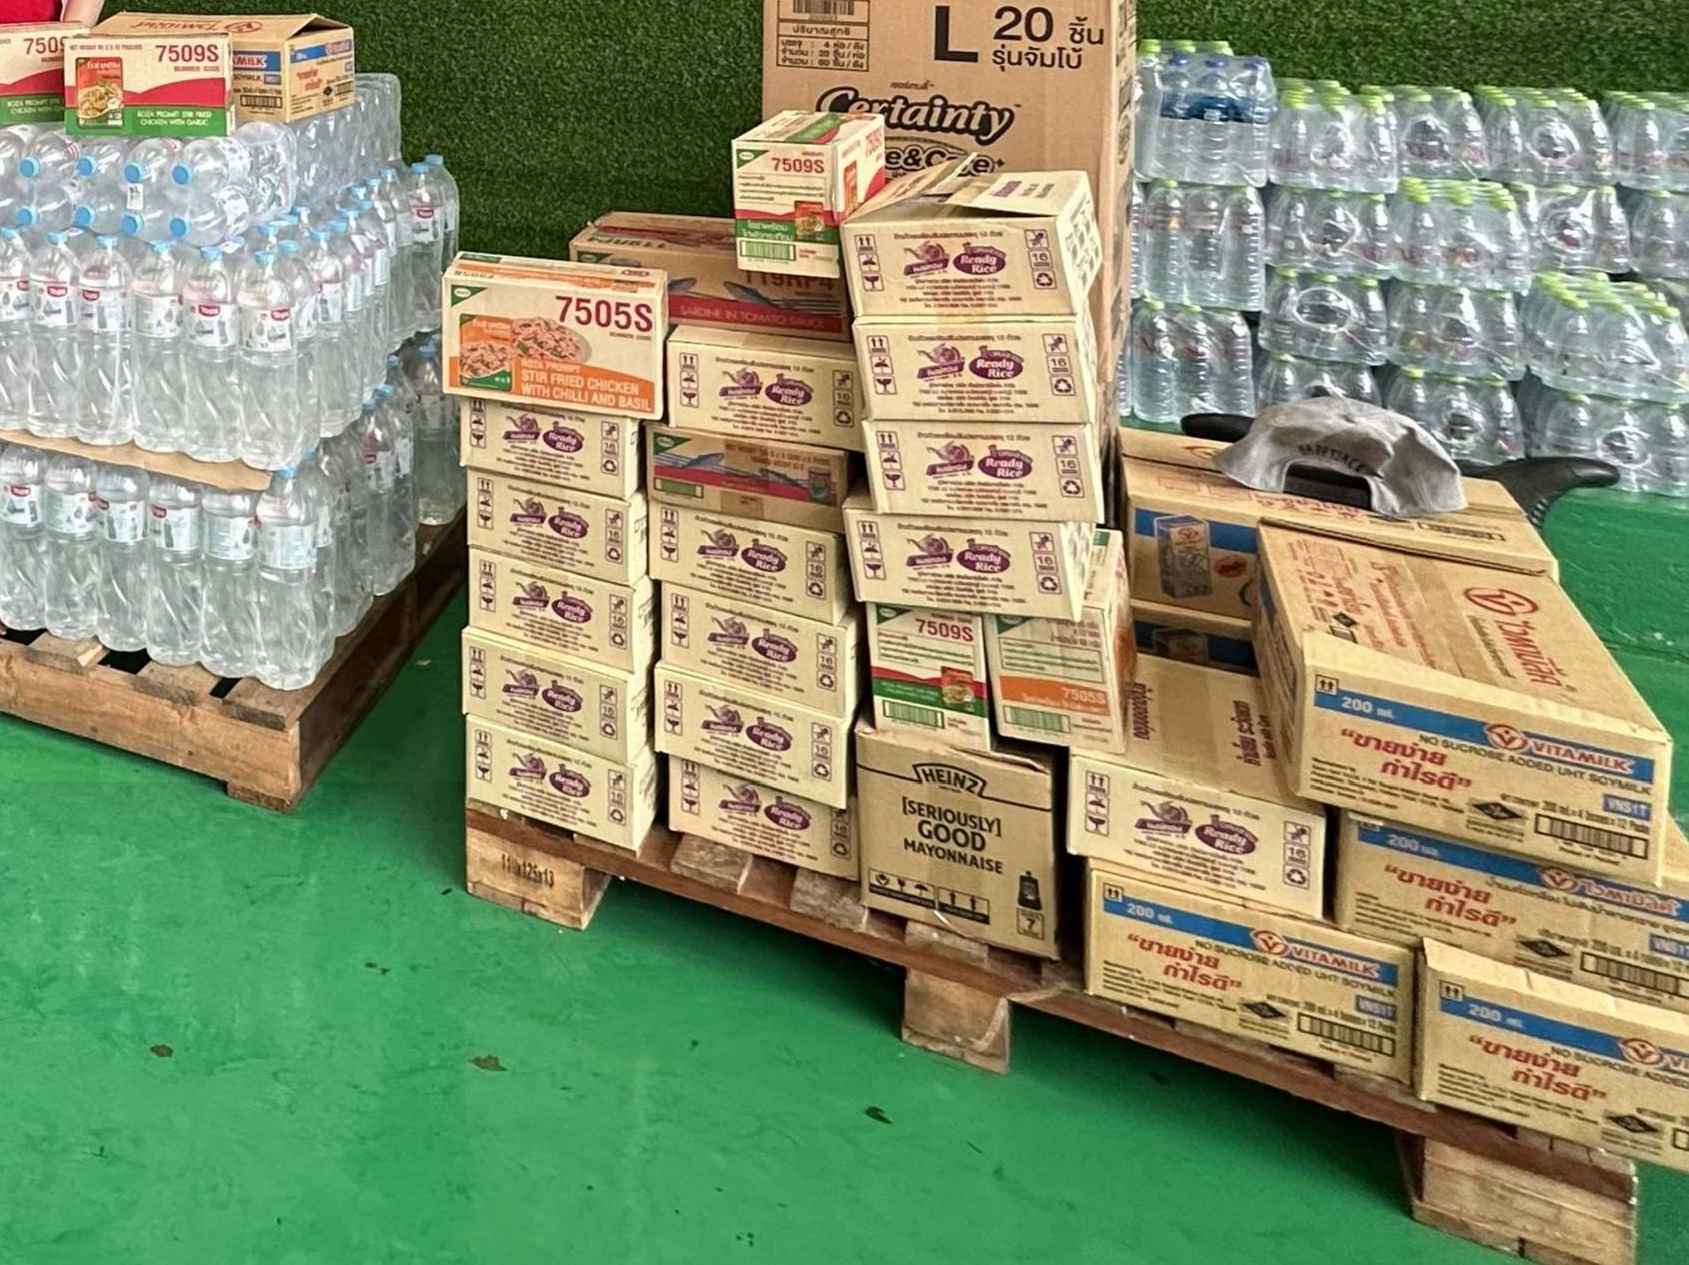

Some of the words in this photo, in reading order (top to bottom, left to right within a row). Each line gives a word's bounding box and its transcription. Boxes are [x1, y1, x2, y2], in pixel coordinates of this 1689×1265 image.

[934, 5, 978, 63] L
[993, 6, 1053, 42] 20
[1069, 16, 1104, 46] ชิ้น
[154, 44, 219, 63] 7509S
[233, 54, 267, 67] MILK
[992, 45, 1083, 72] รุ่นจัมโบ้
[771, 157, 825, 174] 7509S
[960, 255, 996, 267] Ready
[971, 263, 998, 274] Rice
[555, 295, 653, 332] 7505S
[679, 304, 723, 318] SARDINE
[726, 309, 738, 320] IN
[741, 310, 786, 325] TOMATO
[976, 359, 1013, 370] Ready
[987, 368, 1013, 378] Rice
[521, 369, 549, 382] STIR
[550, 371, 585, 386] FRIED
[587, 375, 640, 396] CHICKEN
[521, 383, 550, 397] WITH
[553, 386, 589, 403] CHILLI
[591, 392, 617, 406] AND
[619, 395, 653, 412] BASIL
[985, 457, 1024, 471] Ready
[997, 467, 1023, 478] Rice
[963, 551, 1002, 564] Ready
[975, 560, 1002, 572] Rice
[915, 618, 974, 642] 7509S
[1062, 687, 1105, 704] 7505S
[1341, 696, 1373, 714] 200
[1419, 734, 1439, 746] NO
[1442, 738, 1505, 763] SUCROSE
[1510, 754, 1553, 773] ADDED
[1557, 765, 1585, 779] UHT
[1589, 772, 1652, 796] SOYMILK
[1532, 740, 1629, 772] VITAMILK
[922, 768, 980, 793] HEINZ
[902, 796, 1002, 837] [SERIOUSLY]
[918, 820, 986, 852] GOOD
[1204, 826, 1247, 845] Ready
[1387, 834, 1420, 851] 200
[903, 837, 1004, 874] MAYONNAISE
[1214, 841, 1244, 854] Rice
[1127, 903, 1154, 918] 200
[1195, 940, 1213, 950] NO
[1214, 944, 1270, 965] SUCROSE
[1271, 958, 1310, 976] ADDED
[1314, 971, 1339, 982] UHT
[1342, 976, 1397, 998] SOYMILK
[1291, 945, 1378, 977] VITAMILK
[1468, 1004, 1502, 1022] 200
[1550, 1046, 1571, 1058] NO
[1574, 1050, 1640, 1076] SUCROSE
